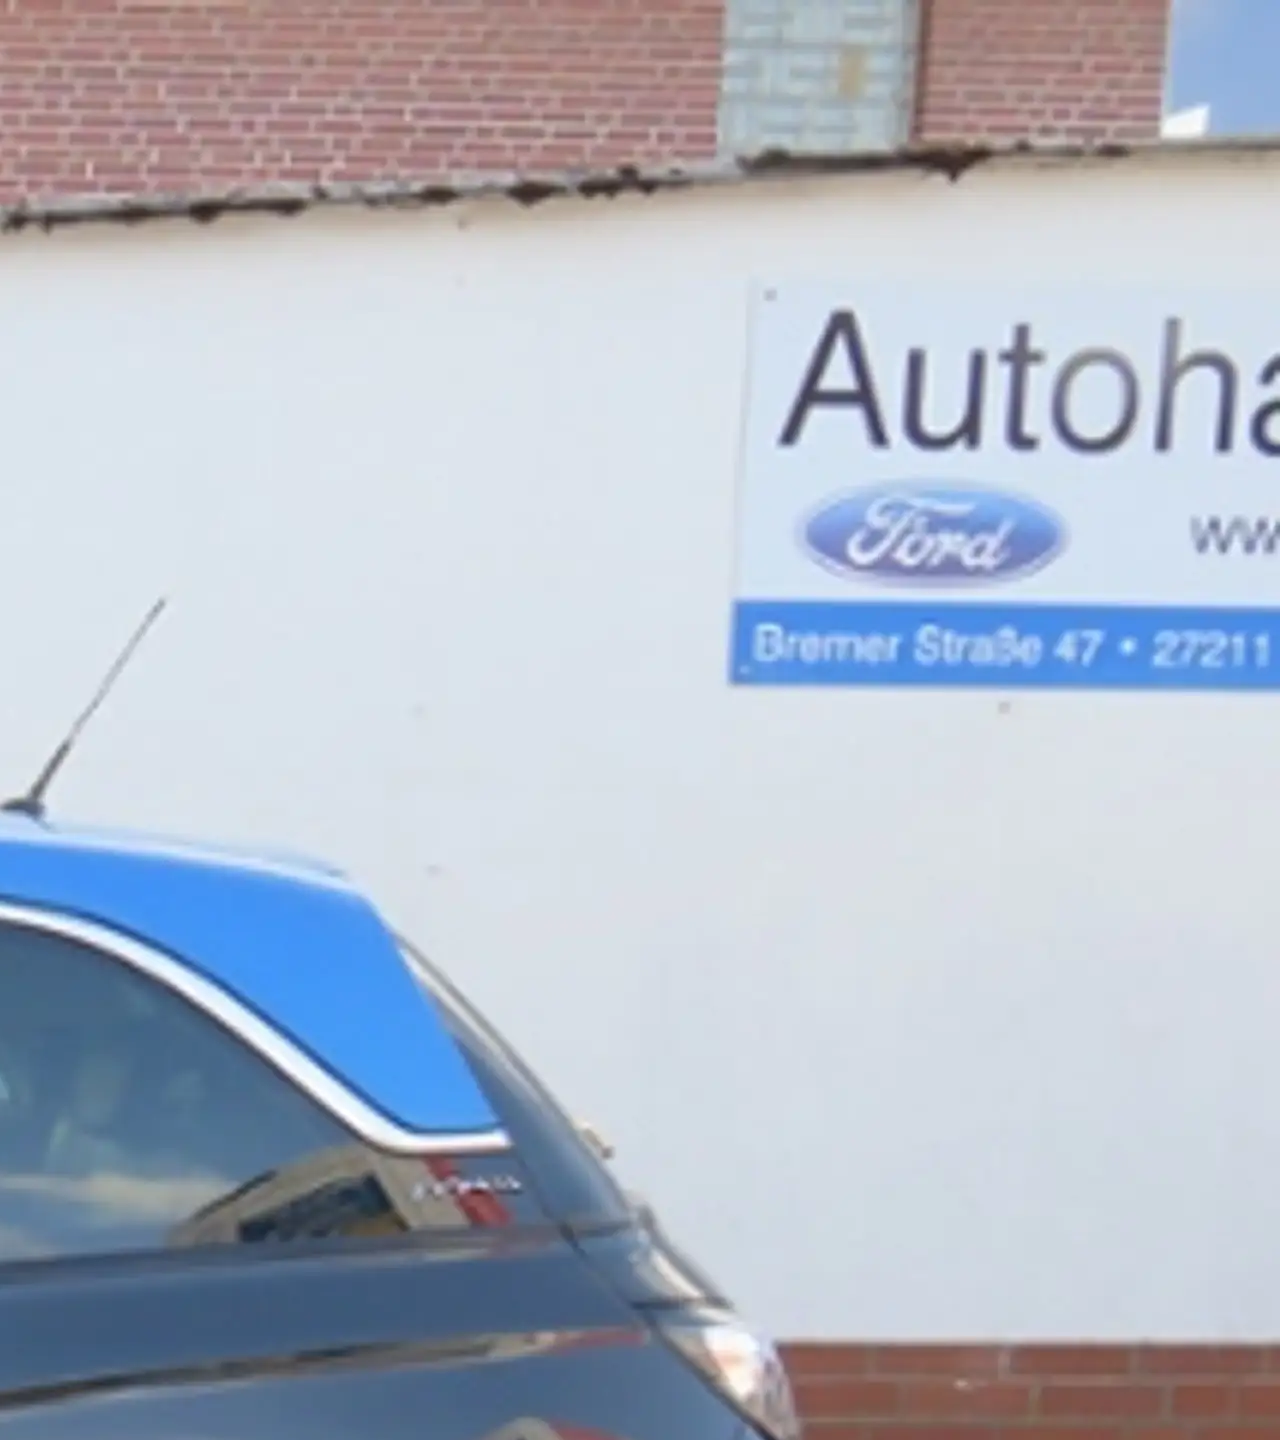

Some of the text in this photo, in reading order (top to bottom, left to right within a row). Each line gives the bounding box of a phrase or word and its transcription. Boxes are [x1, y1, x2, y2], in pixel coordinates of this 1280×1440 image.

[845, 496, 1018, 573] Ford
[753, 622, 902, 665] Bremer
[913, 622, 1044, 669] Straße
[1052, 628, 1106, 669] 47
[1151, 628, 1271, 669] 27211
